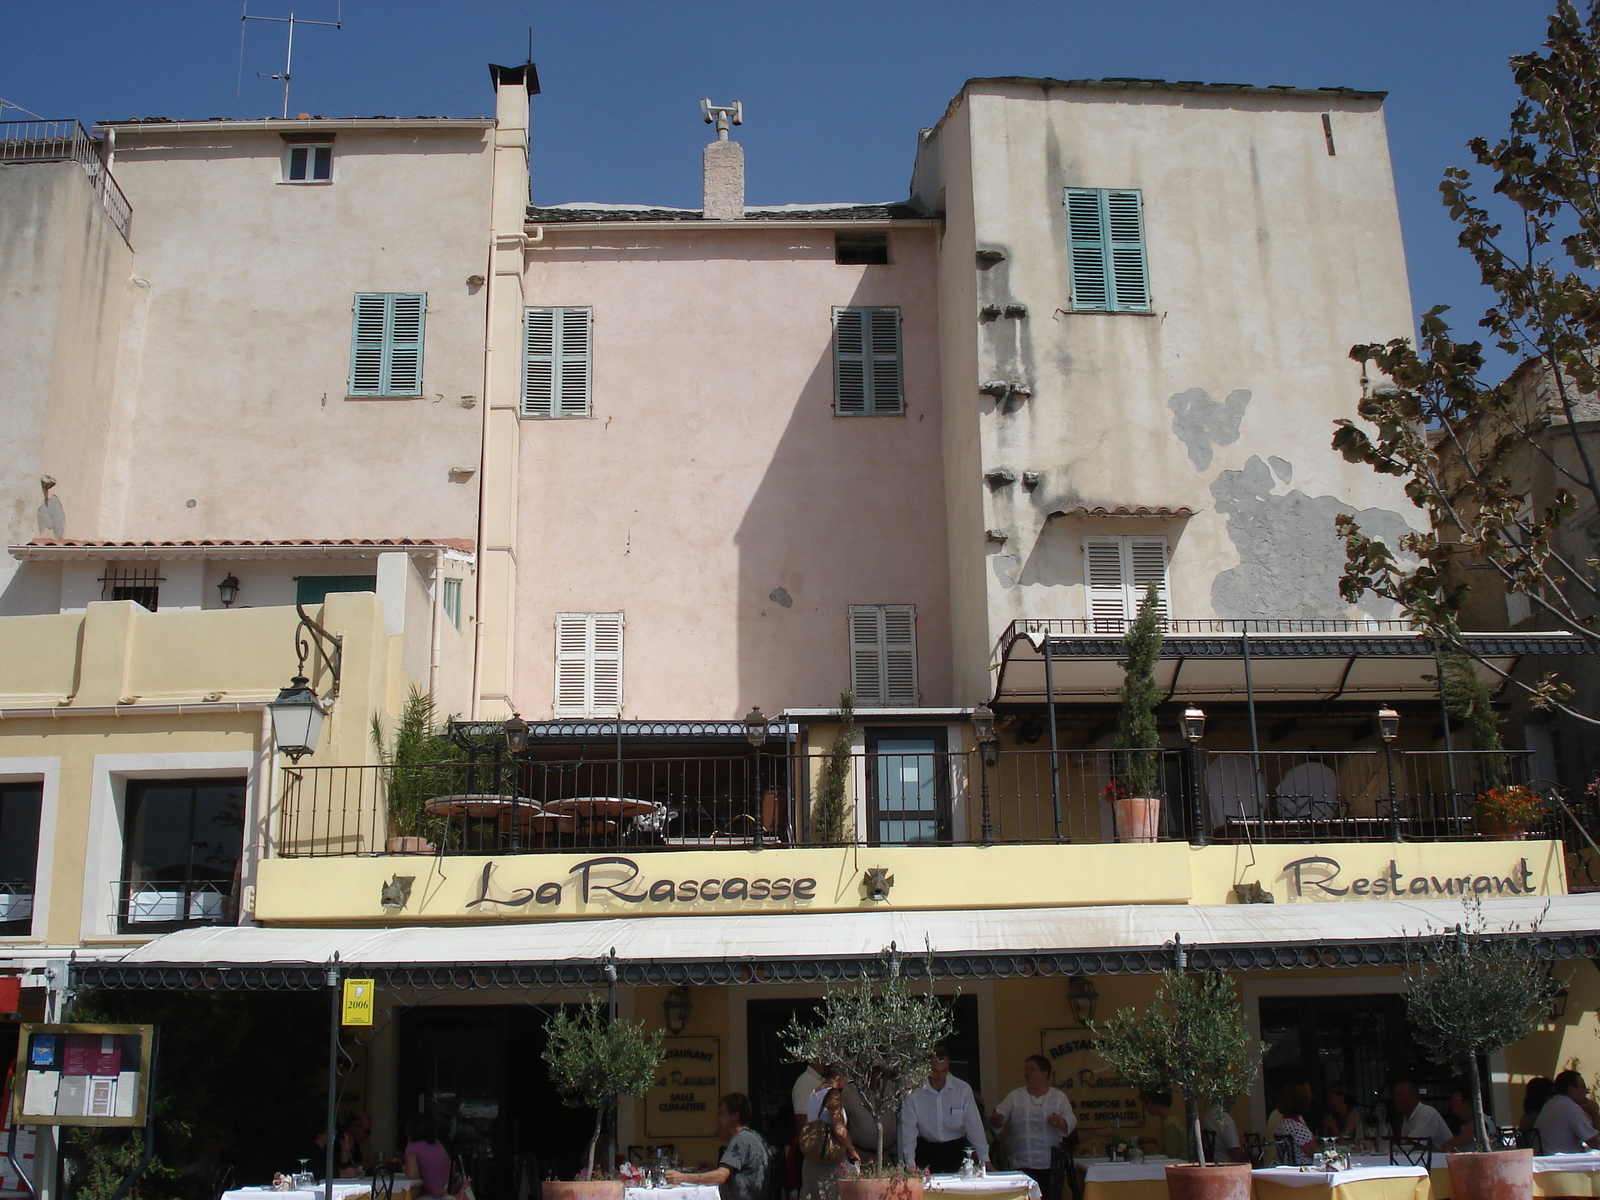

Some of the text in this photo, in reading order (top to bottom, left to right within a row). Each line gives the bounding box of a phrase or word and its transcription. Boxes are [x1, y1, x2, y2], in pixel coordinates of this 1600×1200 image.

[1282, 855, 1537, 897] Restaurant
[465, 856, 817, 908] La Rascasse
[347, 1000, 369, 1009] 2006
[1052, 1070, 1073, 1088] La
[670, 1093, 695, 1101] SALLE
[658, 1102, 706, 1111] CLIMATISEE
[1081, 1099, 1120, 1108] PROPOSE
[1125, 1099, 1136, 1107] SA
[1079, 1110, 1139, 1120] DE SPECIALITES
